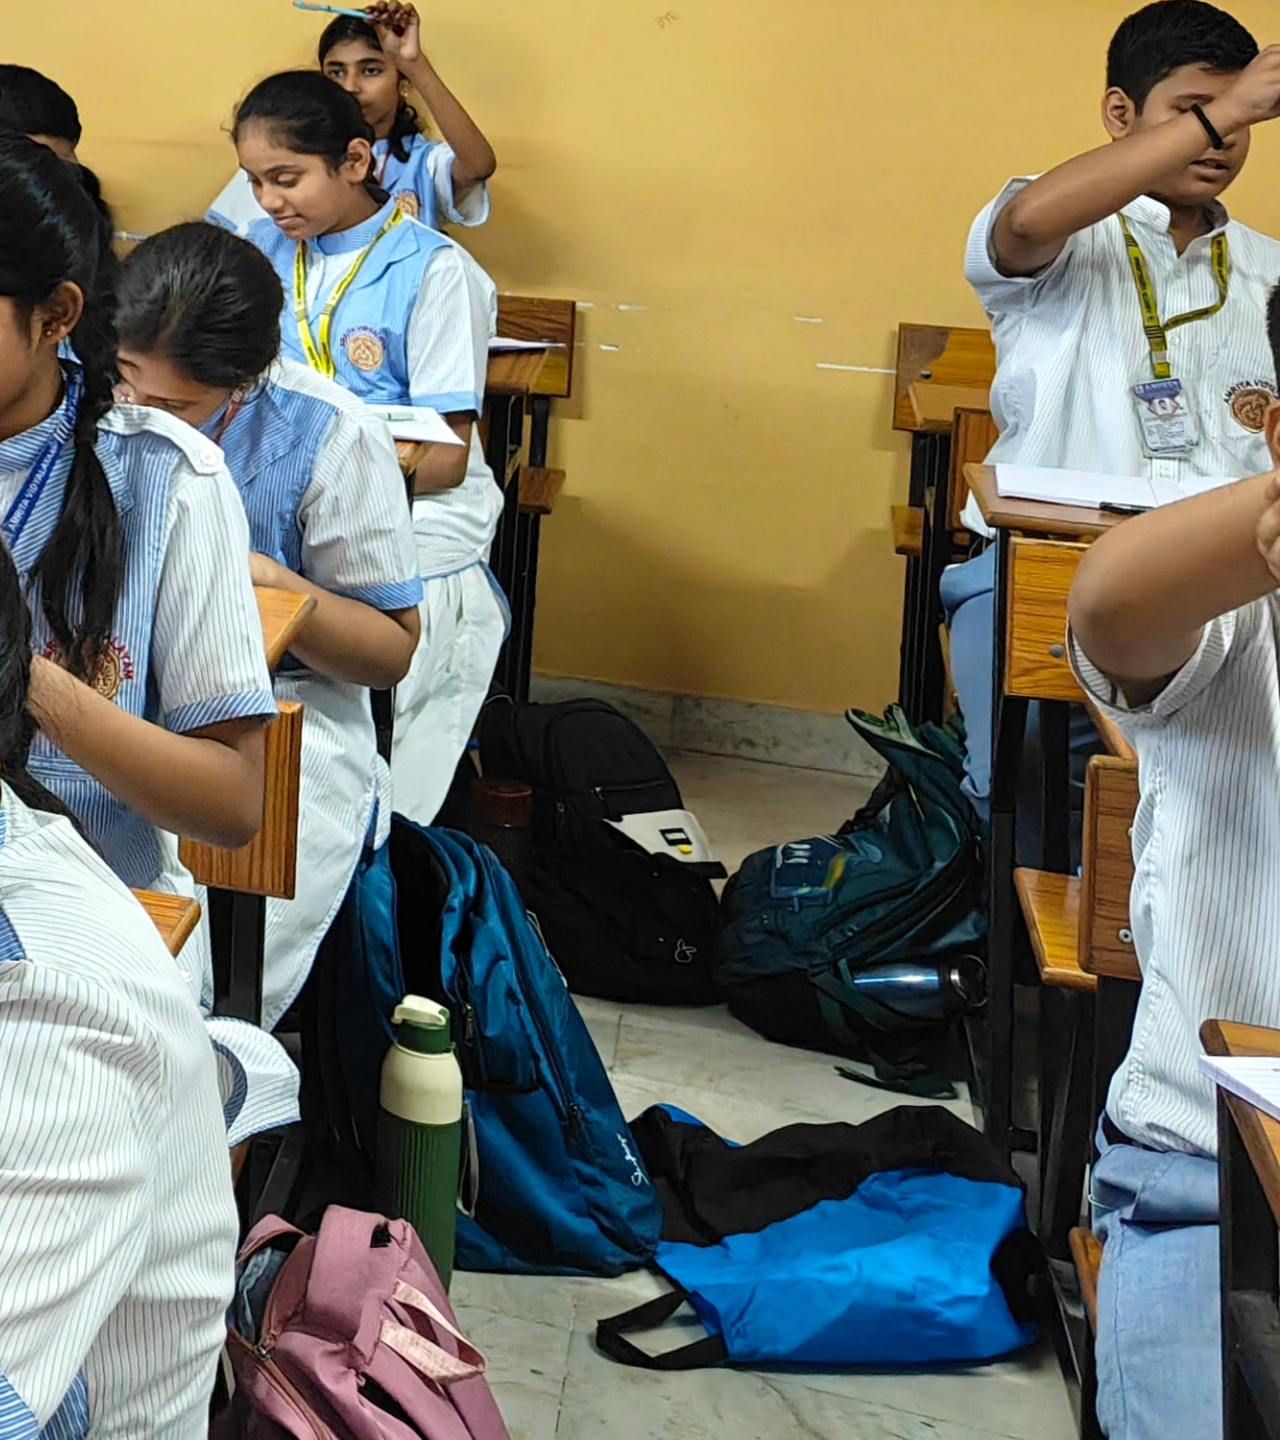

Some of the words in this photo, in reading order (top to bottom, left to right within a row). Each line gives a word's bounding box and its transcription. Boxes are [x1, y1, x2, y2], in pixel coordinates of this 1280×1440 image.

[1223, 379, 1252, 404] AMRITA
[8, 497, 30, 532] AMRITA
[25, 445, 57, 498] VIDYALAYAM
